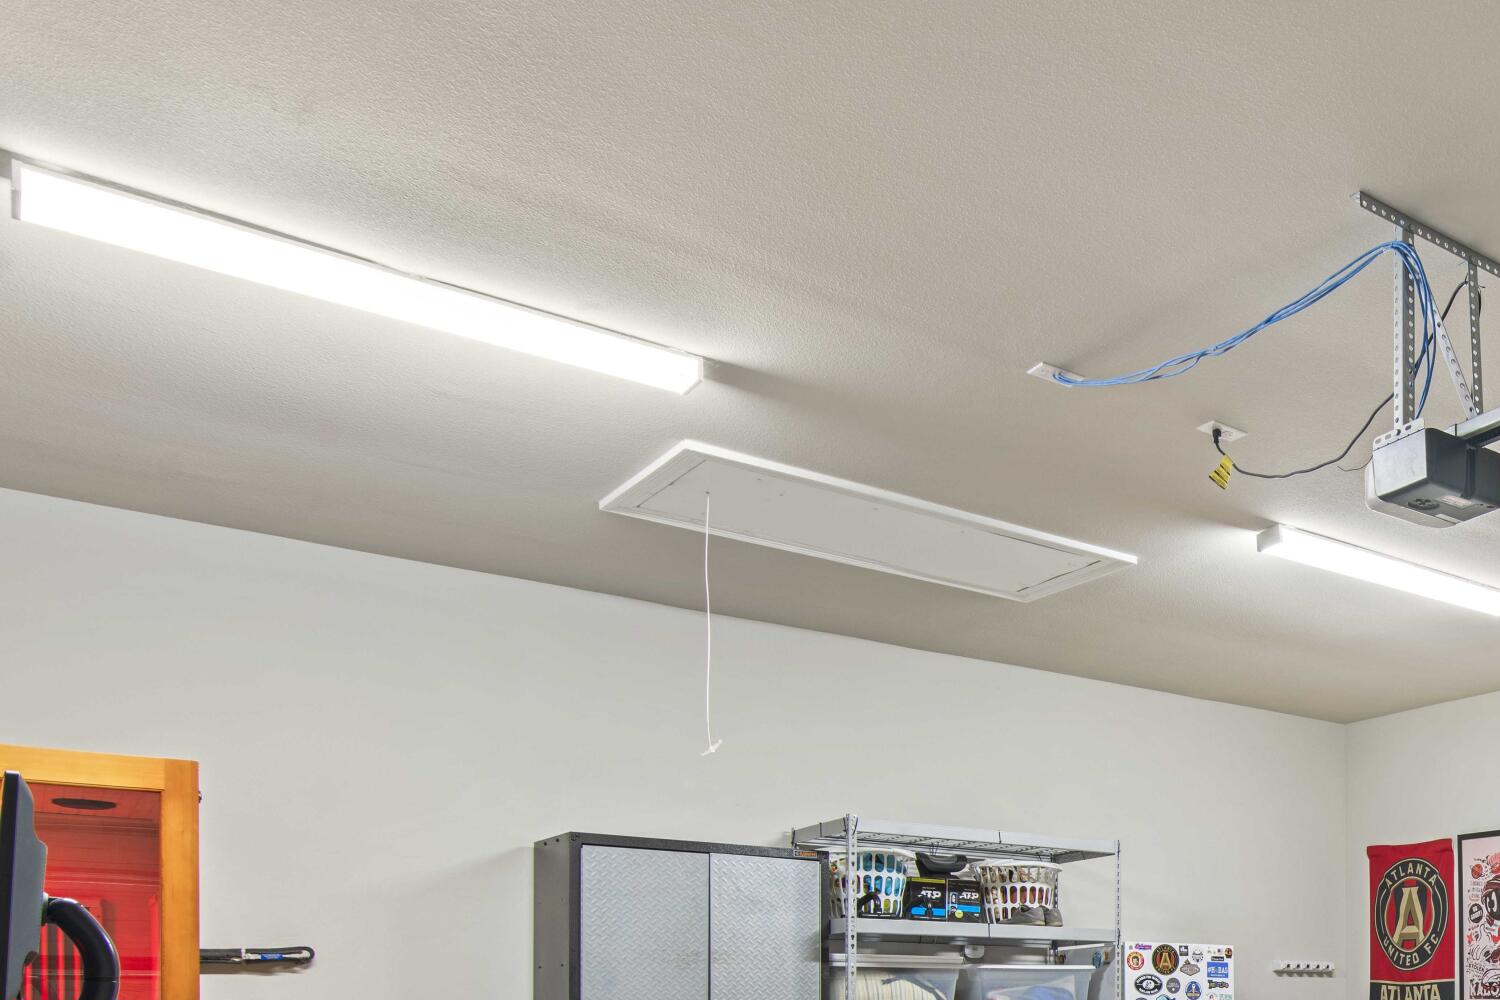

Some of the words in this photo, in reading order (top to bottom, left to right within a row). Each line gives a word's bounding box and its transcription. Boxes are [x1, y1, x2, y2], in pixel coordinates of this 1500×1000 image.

[1384, 862, 1438, 887] ATLANTA
[1383, 936, 1419, 967] UNITED
[1423, 934, 1439, 955] FC
